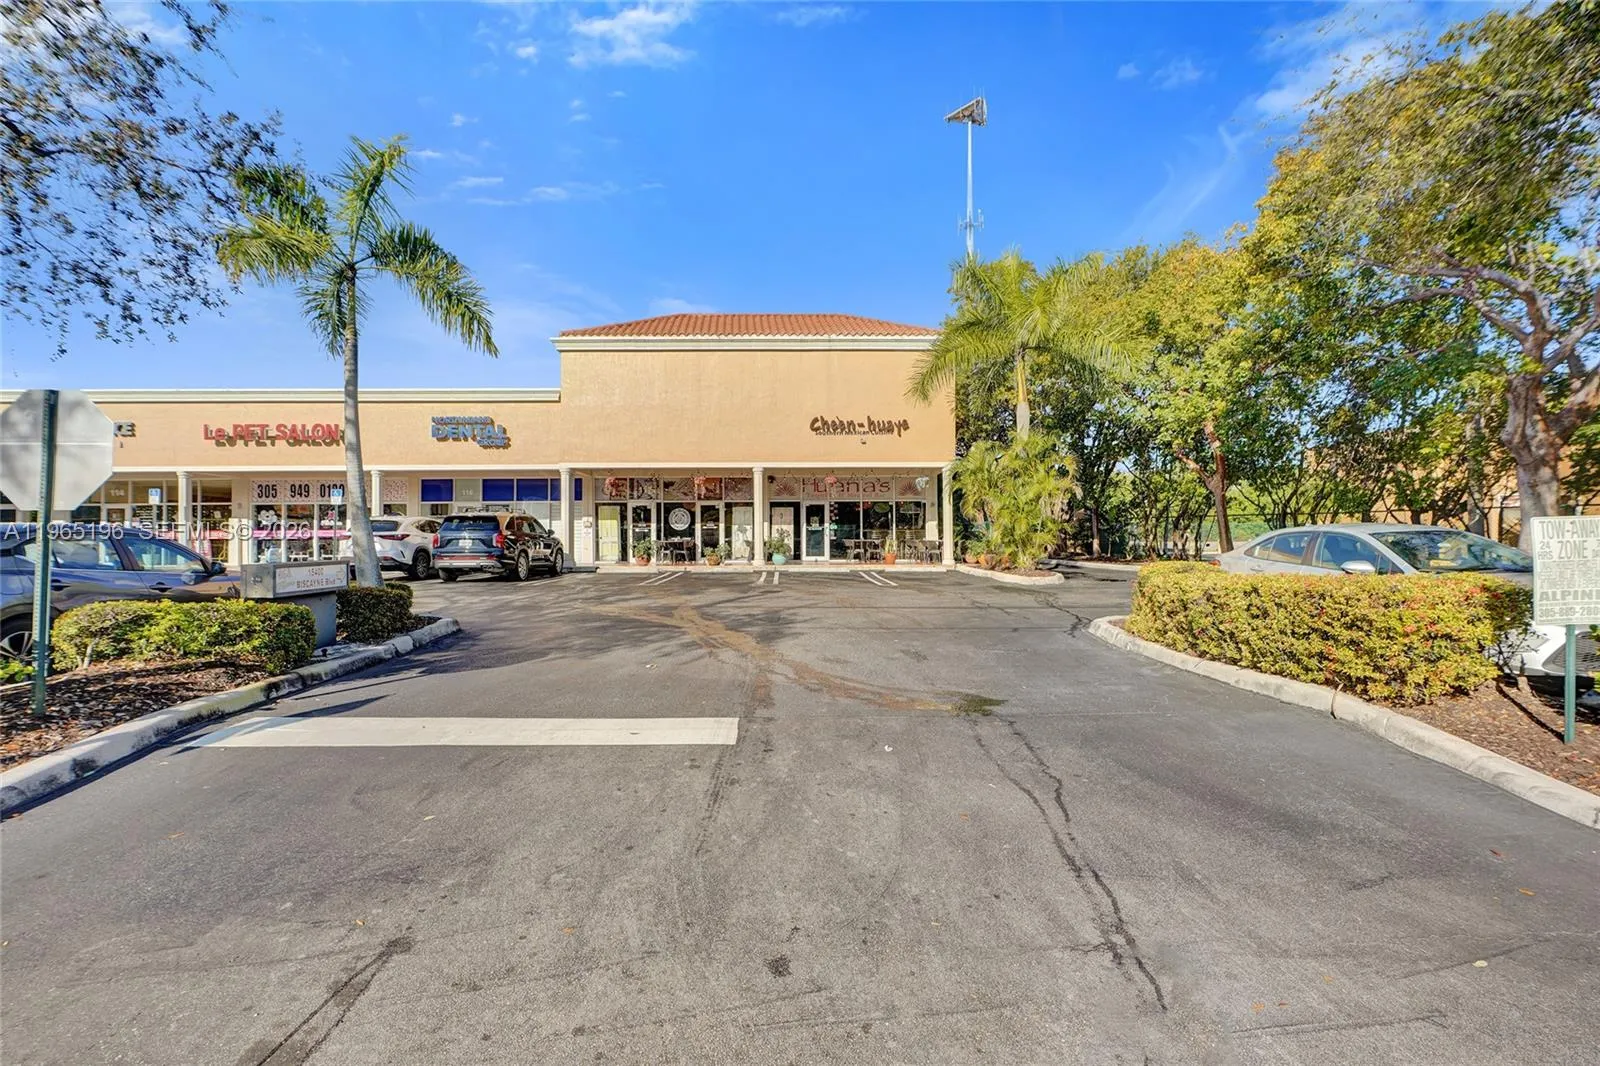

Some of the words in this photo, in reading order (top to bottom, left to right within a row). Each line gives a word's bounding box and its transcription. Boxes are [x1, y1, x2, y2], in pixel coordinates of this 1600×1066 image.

[203, 424, 226, 440] Le
[232, 424, 269, 440] PET
[275, 423, 339, 440] SALON
[432, 424, 505, 439] DENTAL
[257, 484, 278, 498] 305
[290, 484, 310, 498] 949
[1538, 551, 1553, 560] HRS
[1540, 541, 1551, 550] 24
[1557, 540, 1588, 559] ZONE
[297, 578, 324, 589] BISCAYNE
